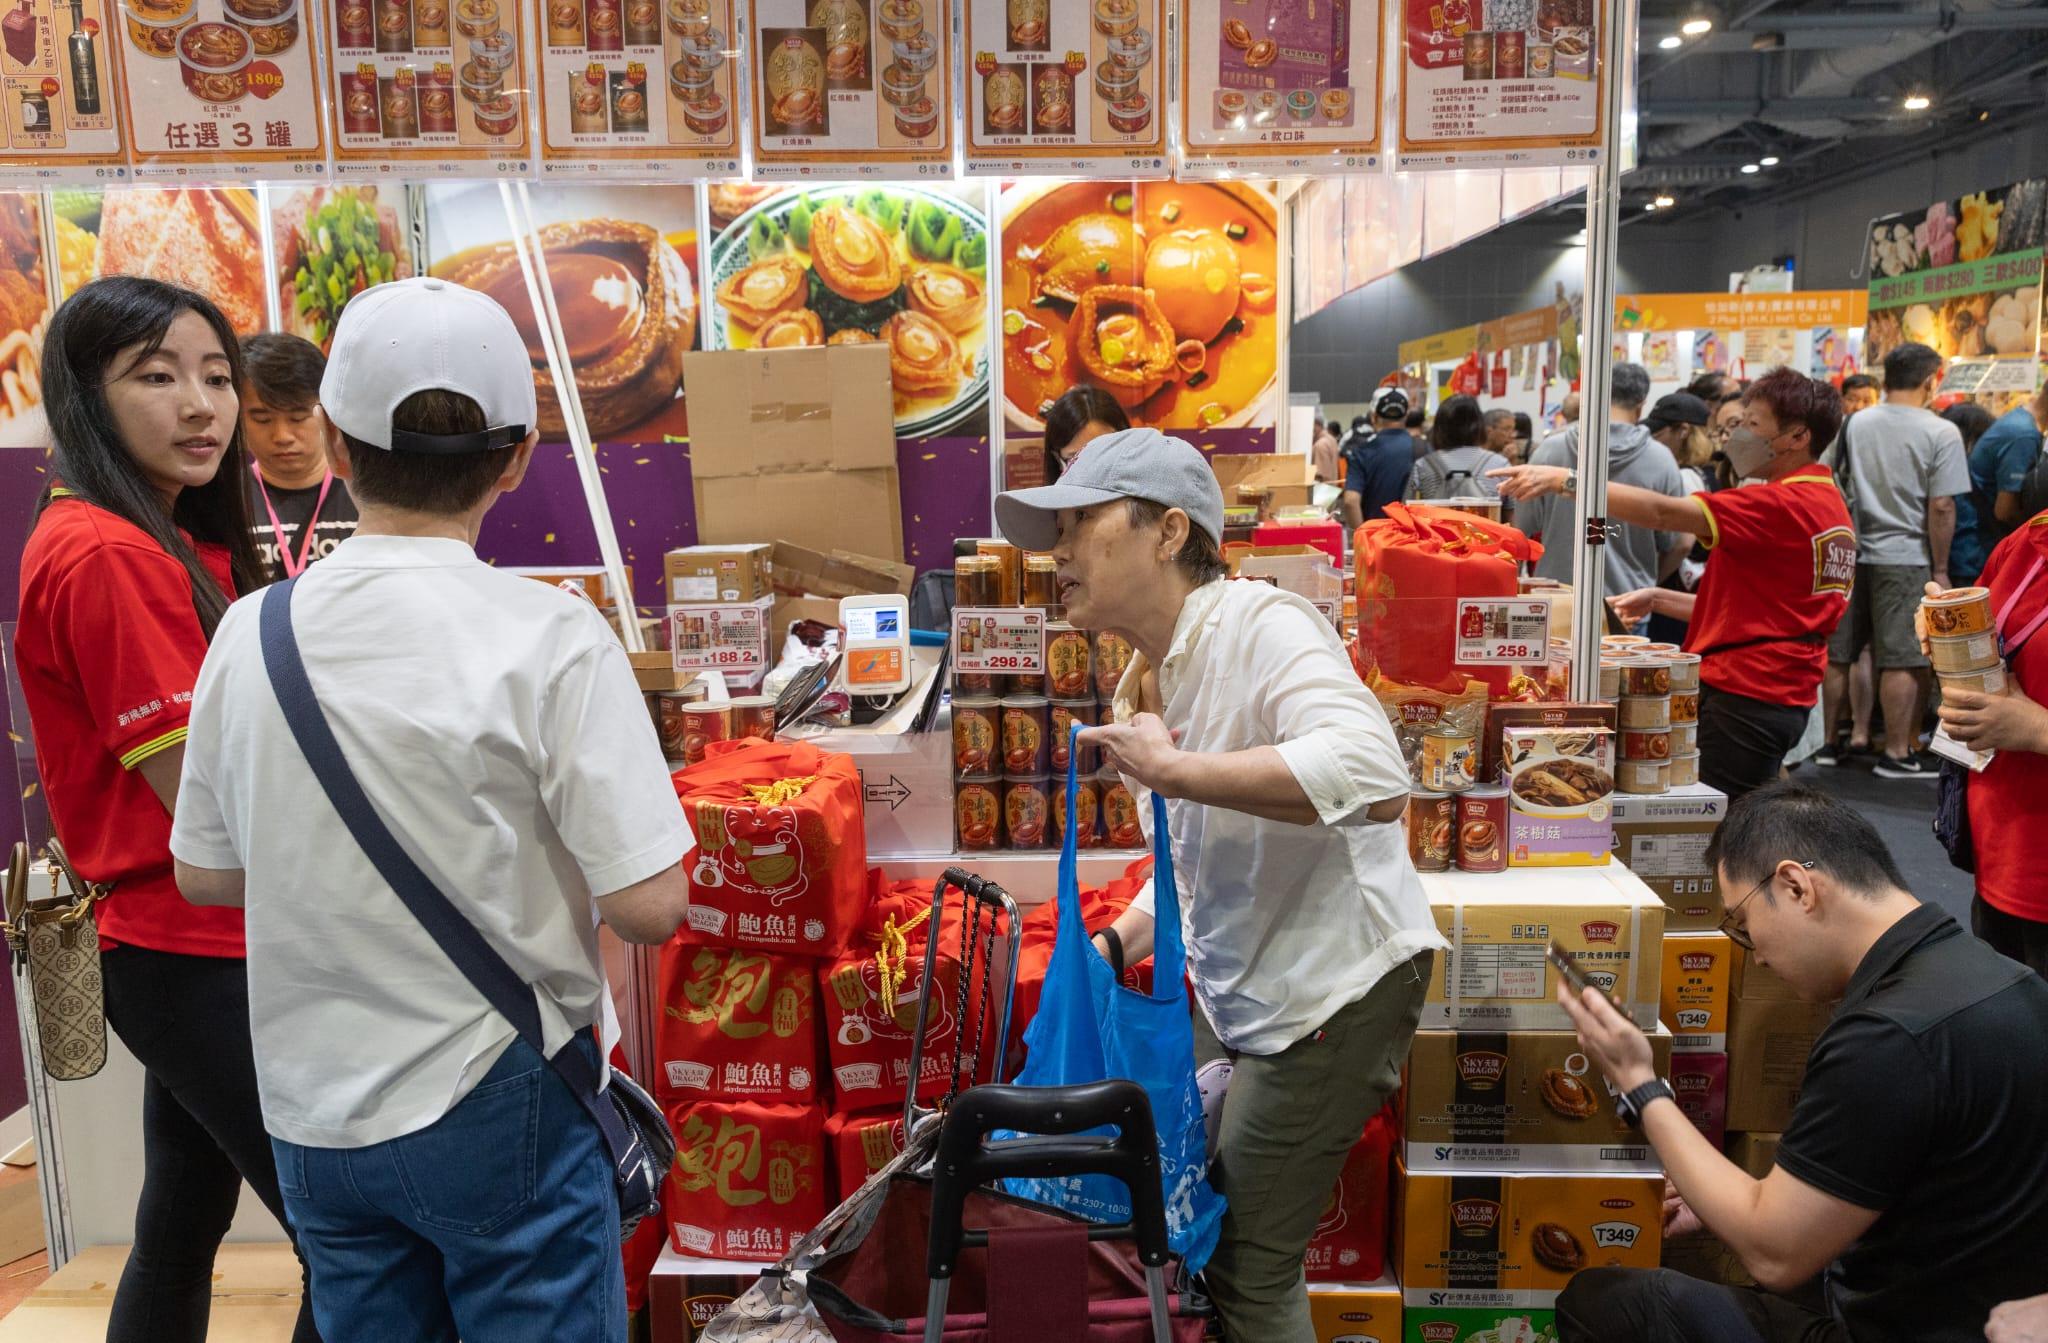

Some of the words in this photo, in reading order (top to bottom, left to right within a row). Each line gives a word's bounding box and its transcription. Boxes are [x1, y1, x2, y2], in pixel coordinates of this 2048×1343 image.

[248, 73, 283, 87] 180g
[165, 122, 220, 149] 任選
[232, 122, 254, 147] 3
[265, 121, 292, 147] 罐
[1271, 131, 1305, 141] 款口味
[1827, 542, 1845, 564] SKY
[1496, 645, 1527, 657] 258
[1405, 703, 1423, 713] SKY
[1405, 712, 1437, 721] DRAGON
[1515, 826, 1561, 841] 茶樹菇
[738, 912, 786, 937] 鮑魚
[1682, 955, 1698, 963] SKY
[1590, 976, 1613, 986] 609
[665, 948, 771, 1040] 鮑
[1679, 1013, 1708, 1024] T349
[1464, 1056, 1483, 1068] SKY
[672, 1066, 687, 1076] SKY
[724, 1062, 772, 1086] 鮑魚
[841, 1069, 857, 1079] SKY
[1464, 1066, 1500, 1076] DRAGON
[672, 1074, 705, 1083] DRAGON
[842, 1075, 875, 1084] DRAGON
[1679, 1076, 1693, 1085] SKY
[1434, 1146, 1454, 1161] SY
[673, 1113, 767, 1207] 鮑
[1458, 1203, 1477, 1214] SKY
[1457, 1213, 1493, 1223] DRAGON
[726, 1226, 774, 1251] 鮑魚
[1596, 1228, 1636, 1242] T349
[1428, 1292, 1448, 1306] SY
[692, 1301, 715, 1314] SKY
[692, 1312, 716, 1322] DRAG
